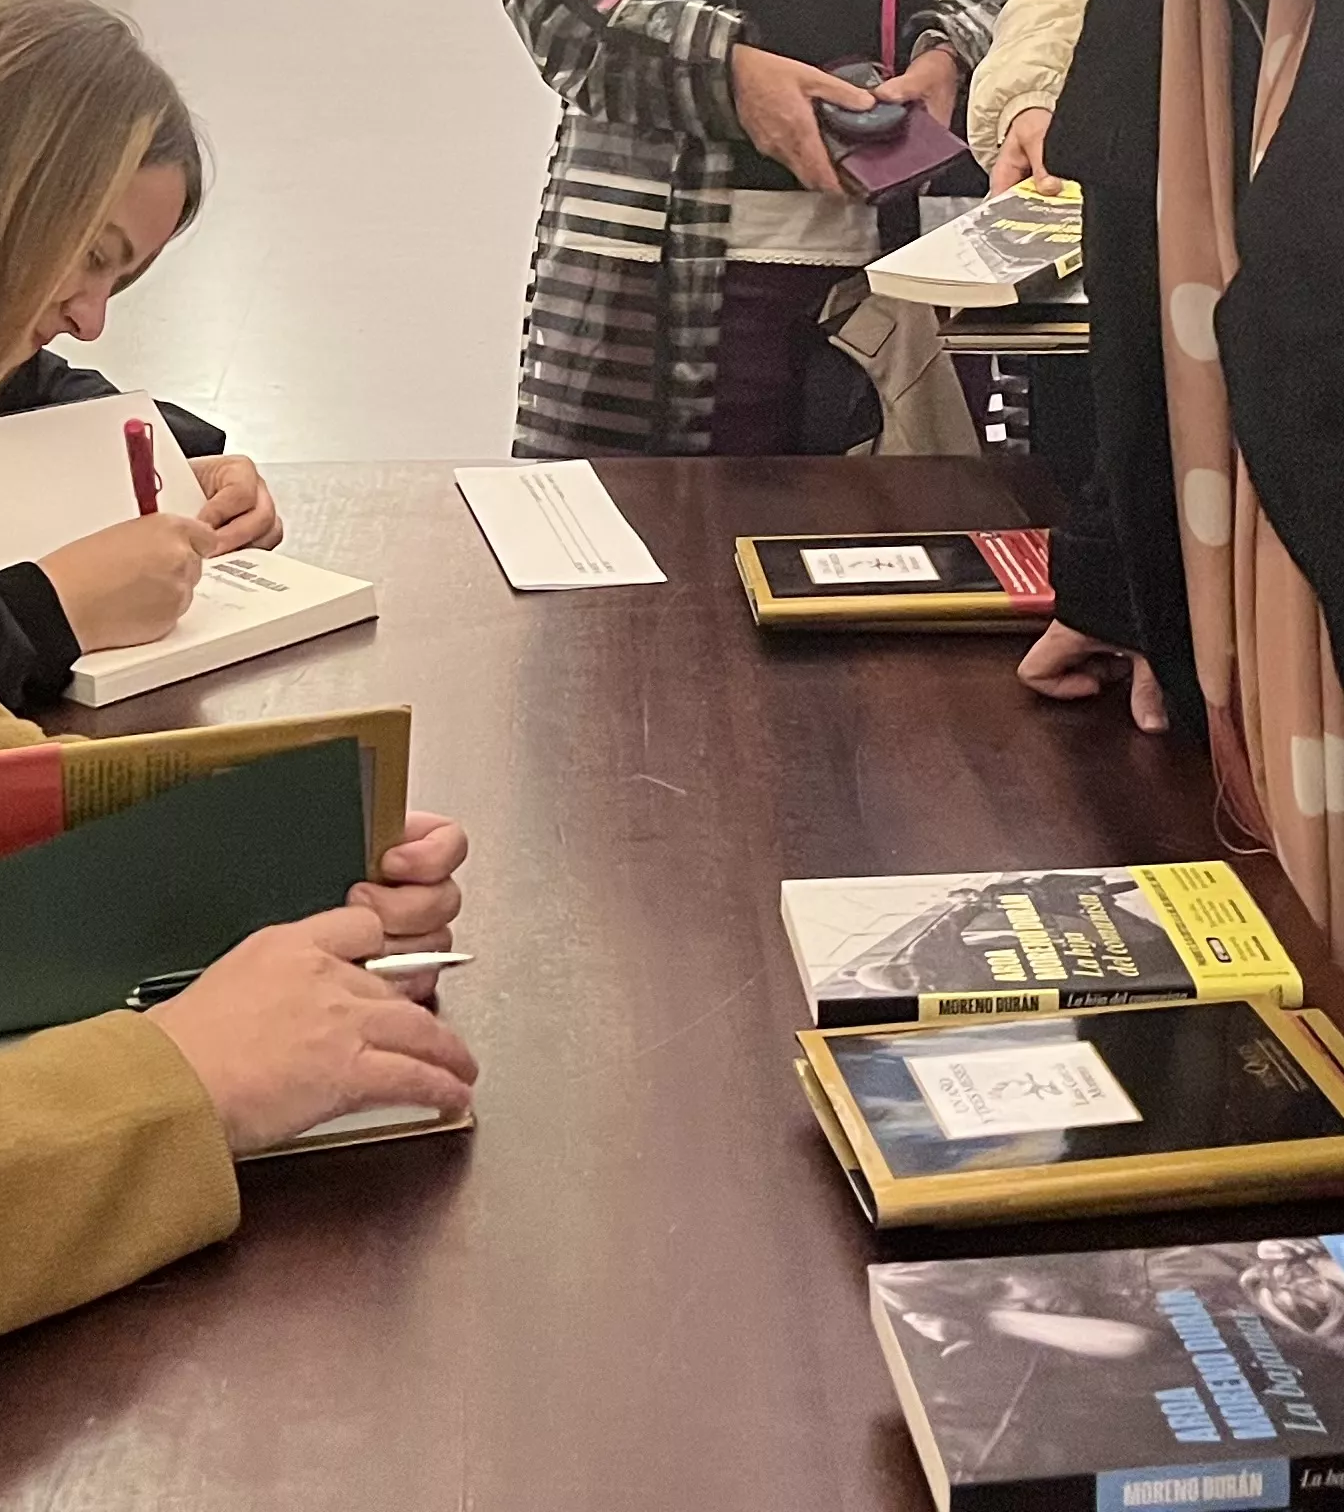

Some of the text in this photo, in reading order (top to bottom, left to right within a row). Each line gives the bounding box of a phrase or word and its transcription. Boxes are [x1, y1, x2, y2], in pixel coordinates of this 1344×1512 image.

[996, 894, 1069, 980] MORENO DURÁN
[1063, 932, 1105, 977] La hija
[1078, 894, 1140, 977] del comunista
[984, 949, 1027, 981] AROA
[939, 993, 1040, 1015] MORENO DURÁN
[1155, 1387, 1222, 1441] AROA
[1192, 1352, 1278, 1439] MORENO
[1283, 1402, 1328, 1433] La
[1123, 1468, 1263, 1506] MORENO DURÁN
